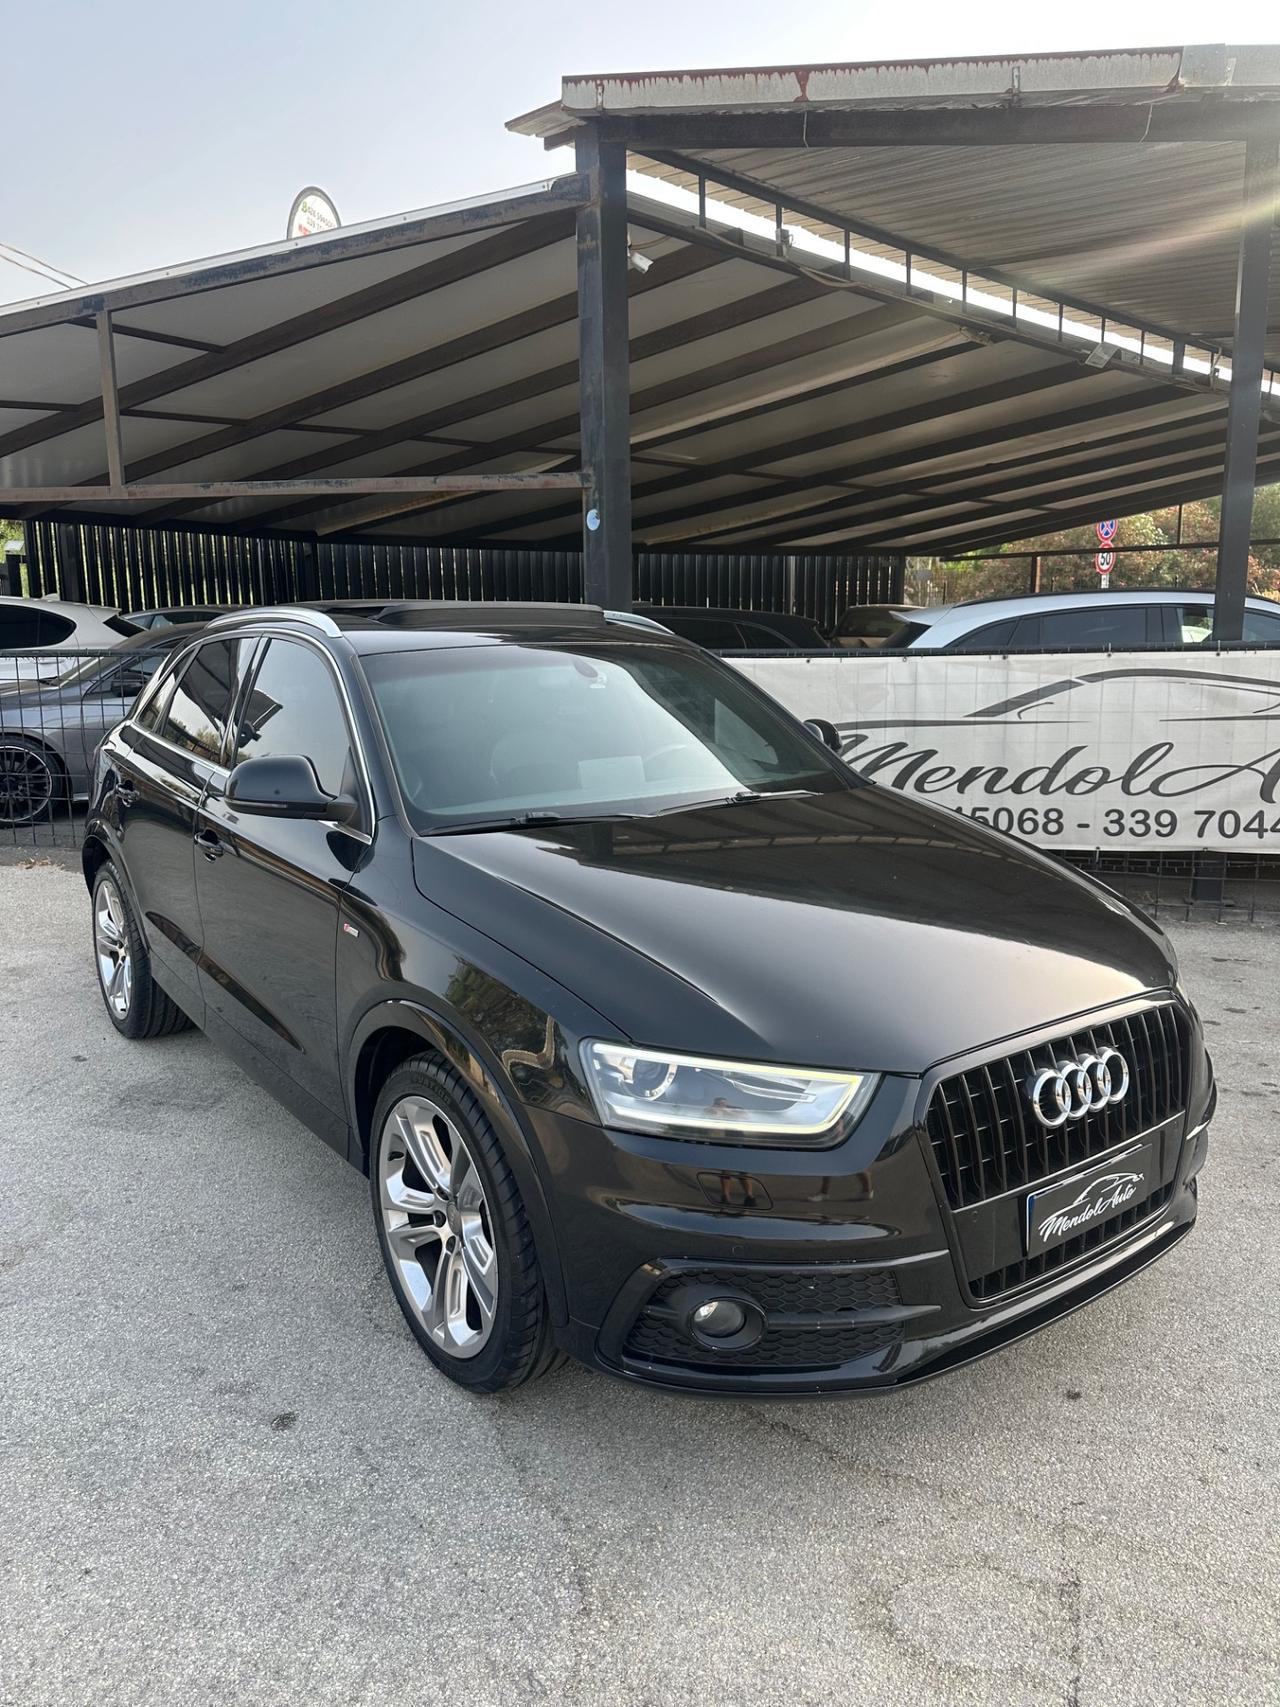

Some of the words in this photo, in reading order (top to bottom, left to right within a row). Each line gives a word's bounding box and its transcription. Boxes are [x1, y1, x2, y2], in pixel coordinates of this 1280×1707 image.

[1100, 551, 1111, 566] 50
[954, 806, 1064, 835] 5068
[1103, 808, 1178, 838] 339
[1039, 1184, 1137, 1242] MendolAuto
